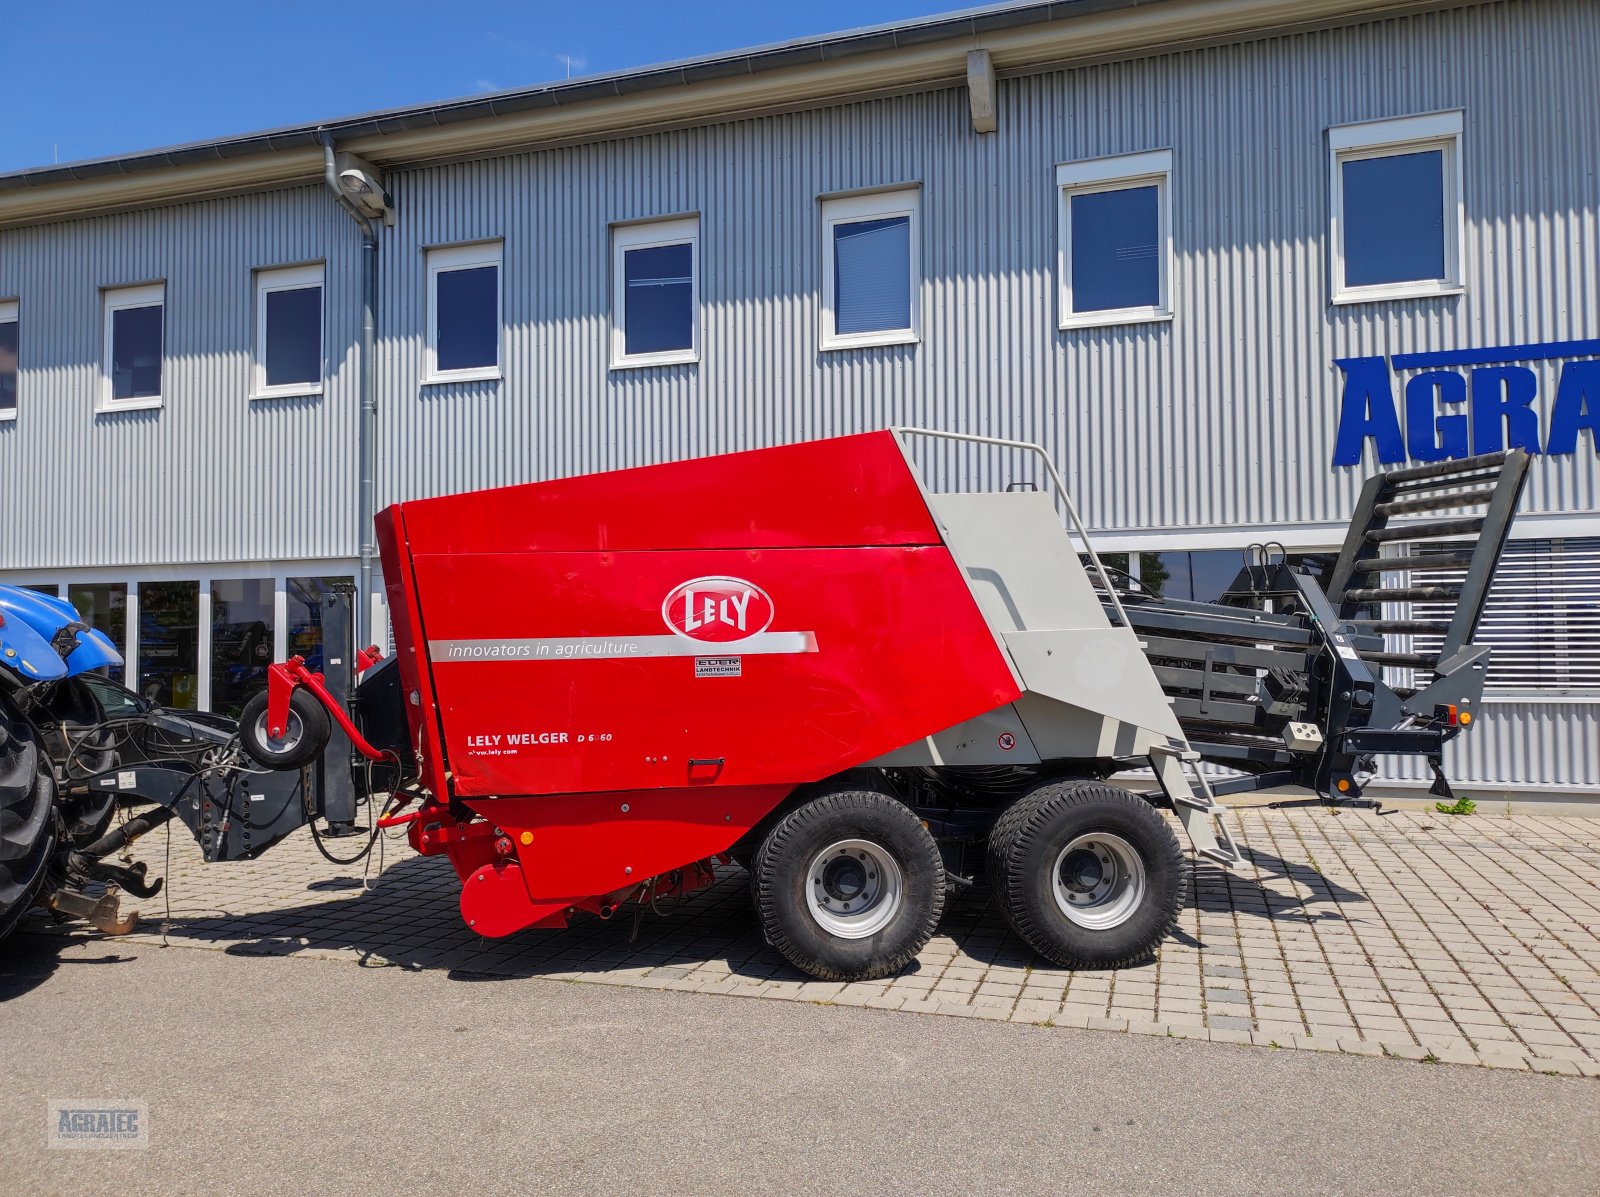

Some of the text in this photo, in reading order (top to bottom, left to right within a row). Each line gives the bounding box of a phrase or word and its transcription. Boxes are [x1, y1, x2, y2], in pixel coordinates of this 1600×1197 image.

[685, 589, 751, 632] LELY
[448, 641, 638, 657] innovators in agriculture
[467, 735, 501, 746] LELY
[507, 732, 568, 745] WELGER
[577, 734, 585, 742] D
